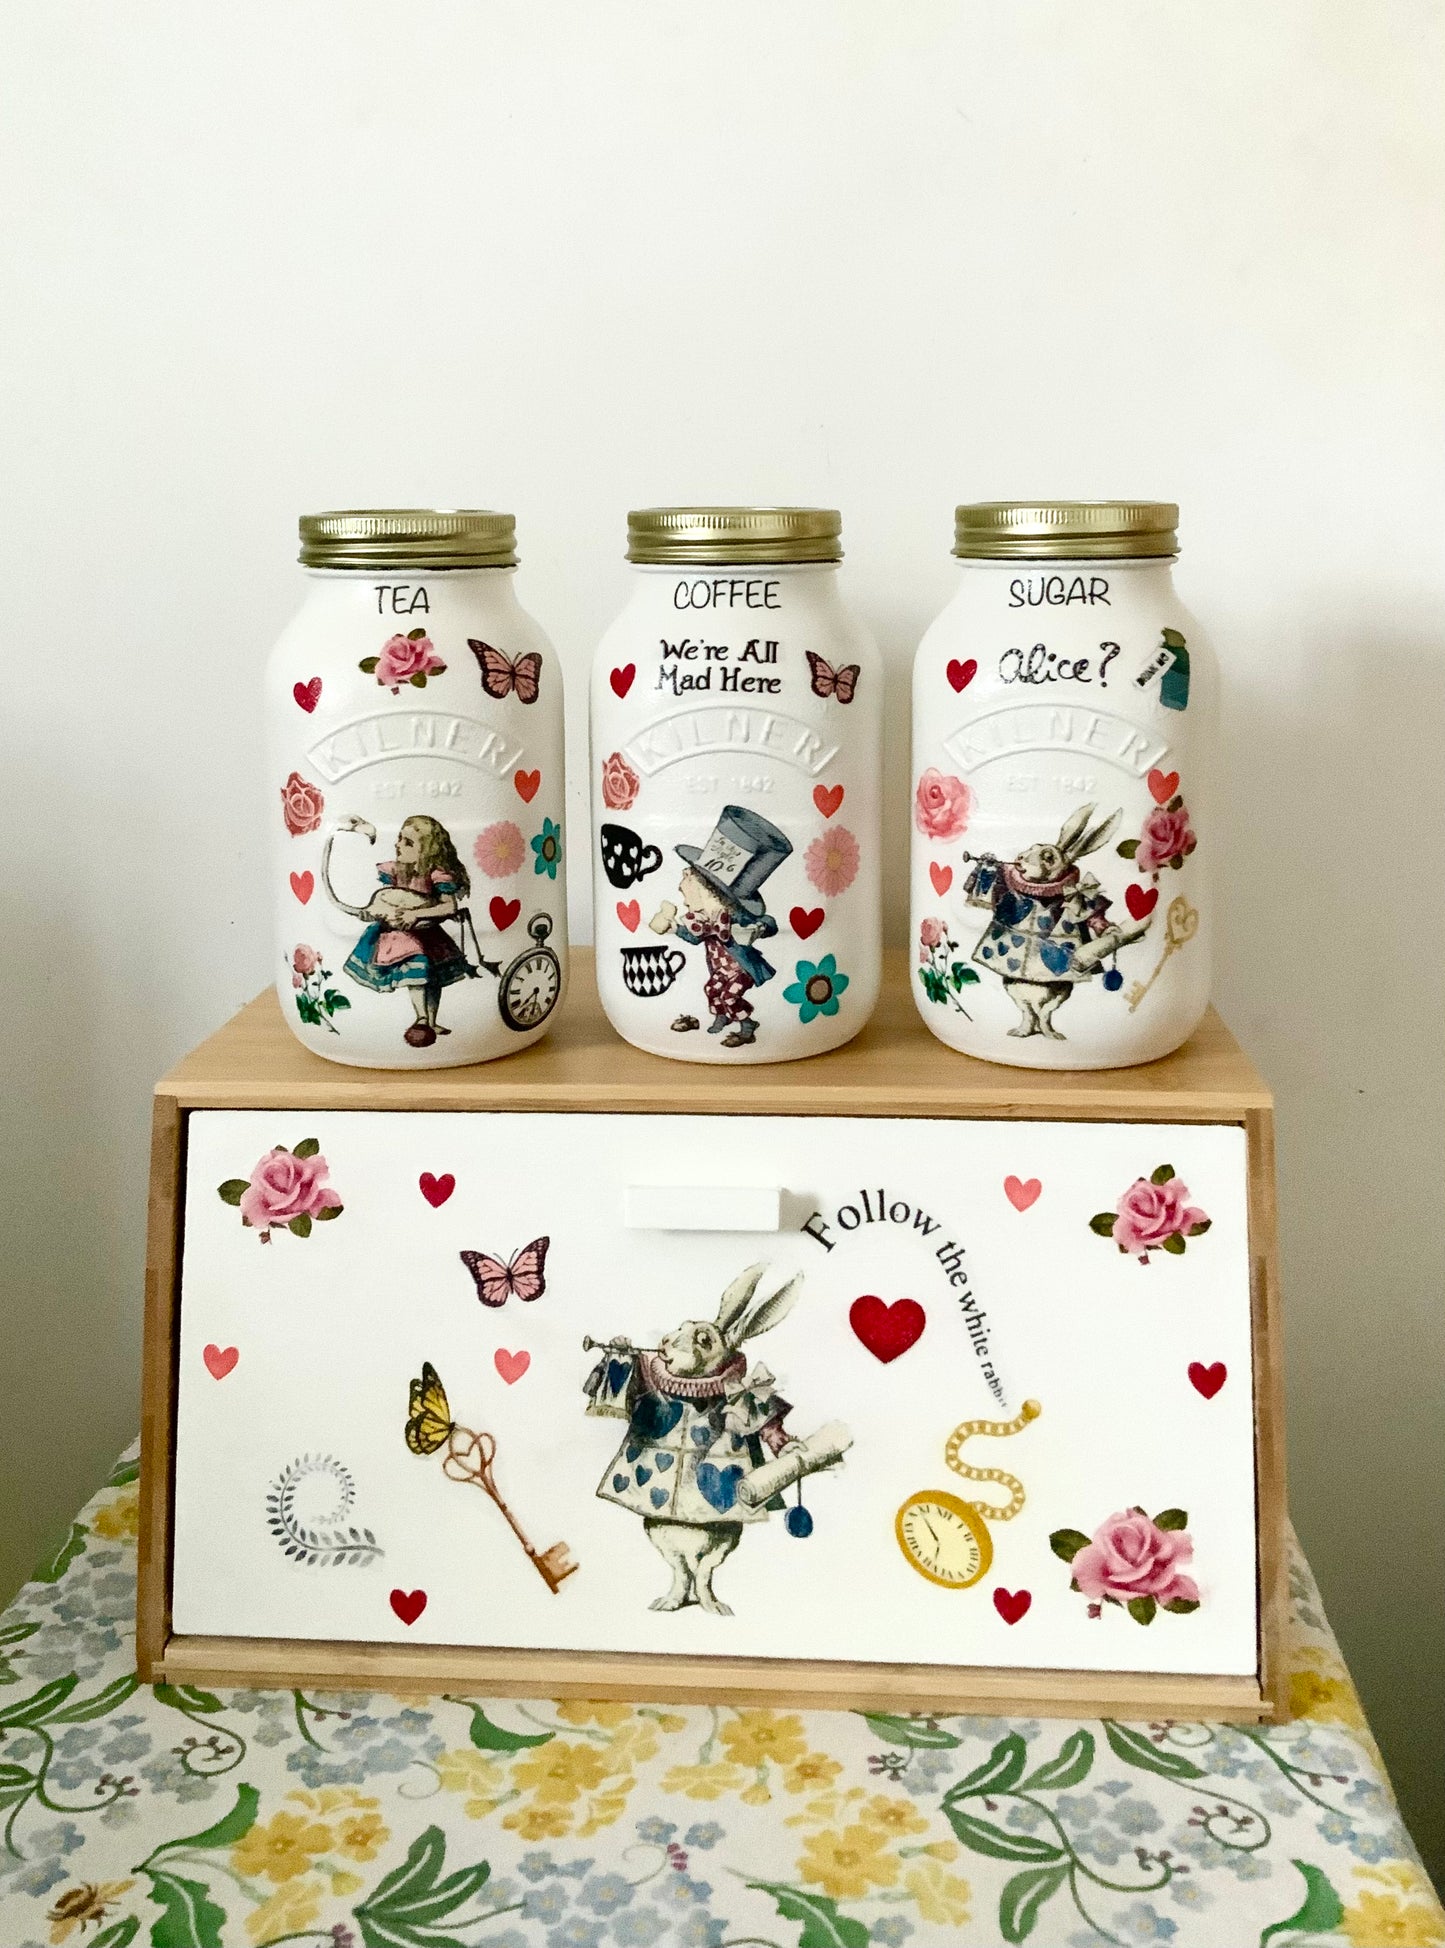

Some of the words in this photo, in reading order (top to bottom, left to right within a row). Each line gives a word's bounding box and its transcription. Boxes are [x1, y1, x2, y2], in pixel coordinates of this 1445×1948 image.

[374, 585, 431, 615] TEA
[673, 580, 782, 610] COFFEE
[1008, 576, 1112, 608] SUGAR
[659, 639, 729, 661] We're
[737, 639, 780, 664] All
[998, 641, 1121, 688] Alice?
[654, 664, 713, 697] Mad
[719, 667, 782, 695] Here
[318, 716, 508, 773] KILNER
[636, 711, 825, 767] KILNER
[957, 708, 1151, 766] KILNER
[801, 1188, 942, 1253] Follow
[935, 1240, 968, 1288] the
[959, 1291, 991, 1357] white
